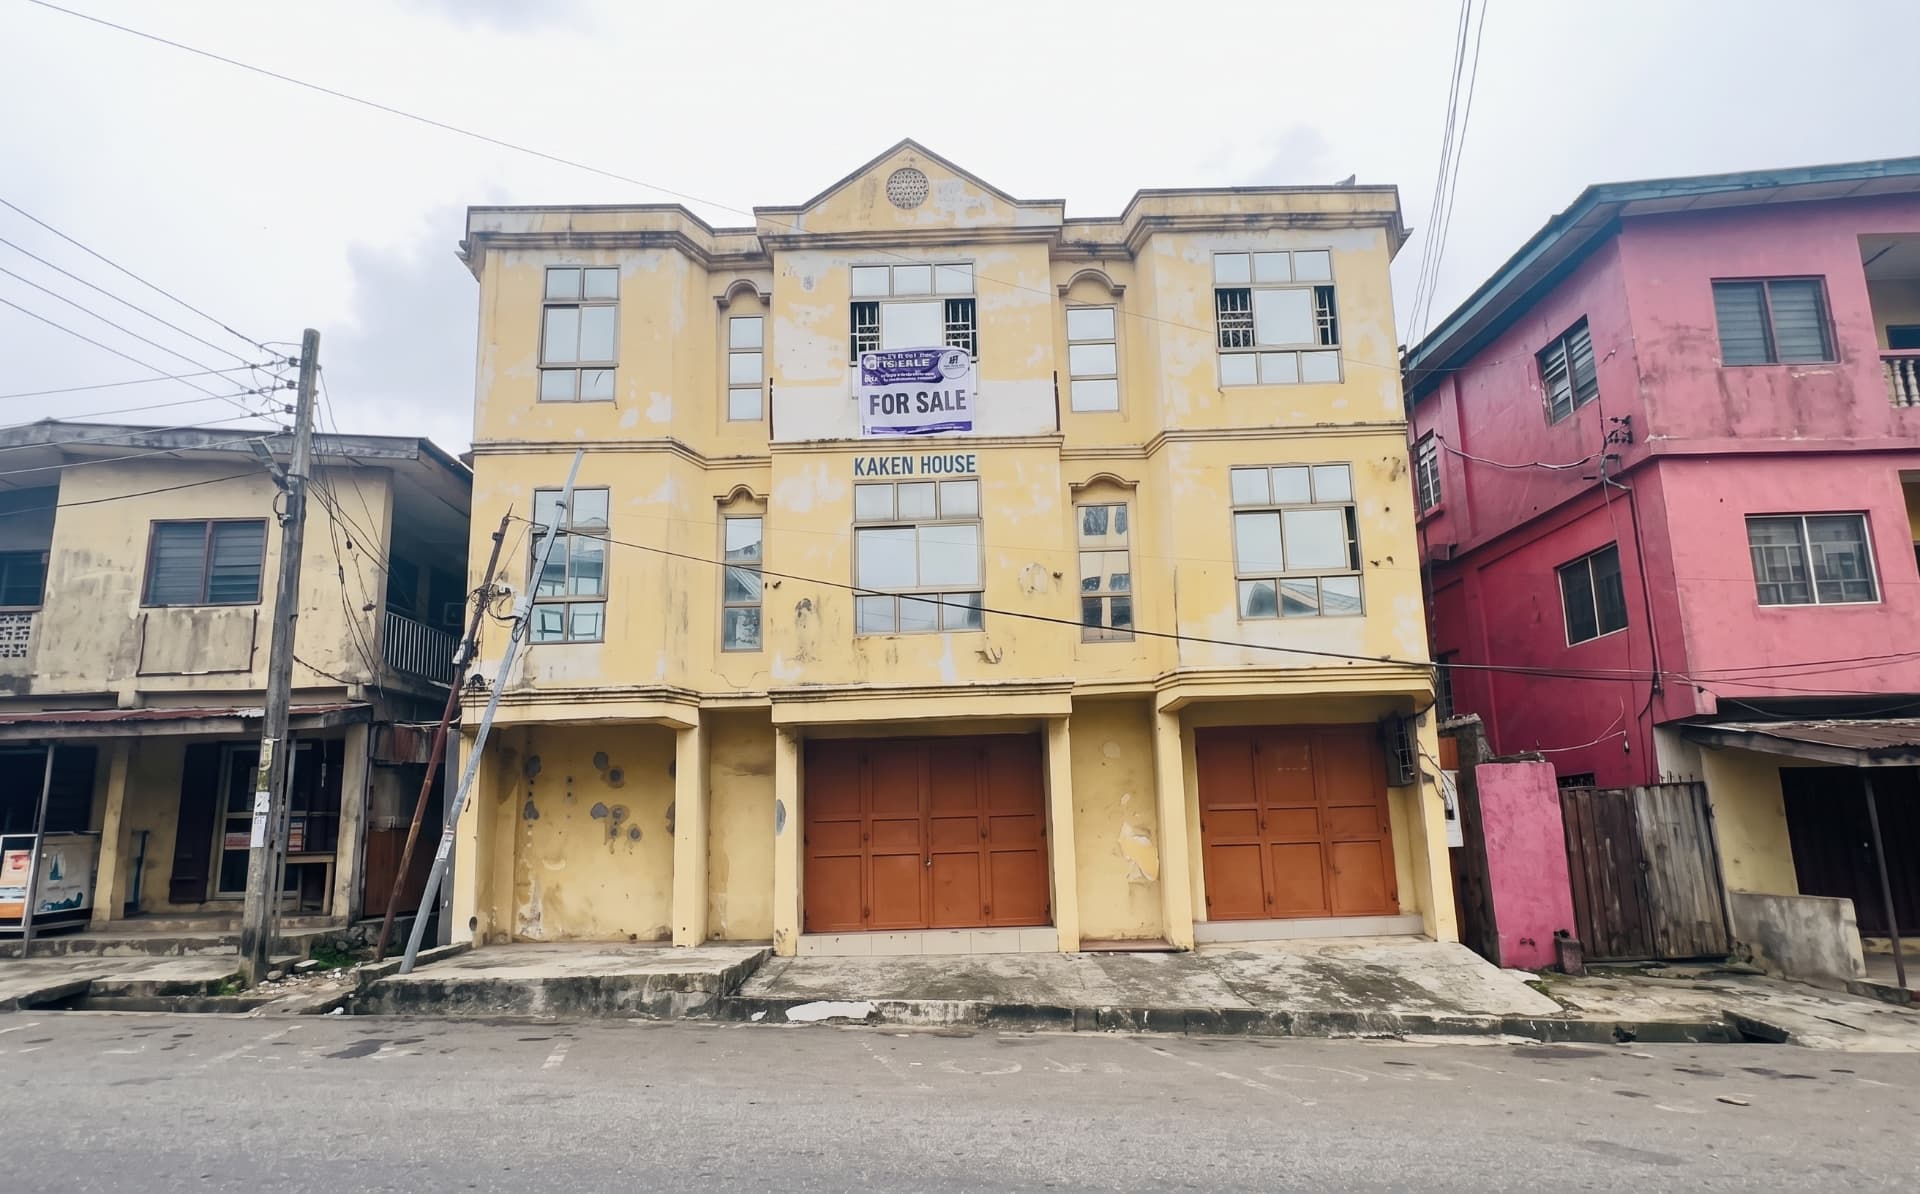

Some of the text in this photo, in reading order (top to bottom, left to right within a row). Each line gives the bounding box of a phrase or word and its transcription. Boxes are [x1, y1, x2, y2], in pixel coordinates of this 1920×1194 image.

[869, 389, 967, 416] FOR SALE
[854, 454, 976, 476] KAKEN HOUSE
